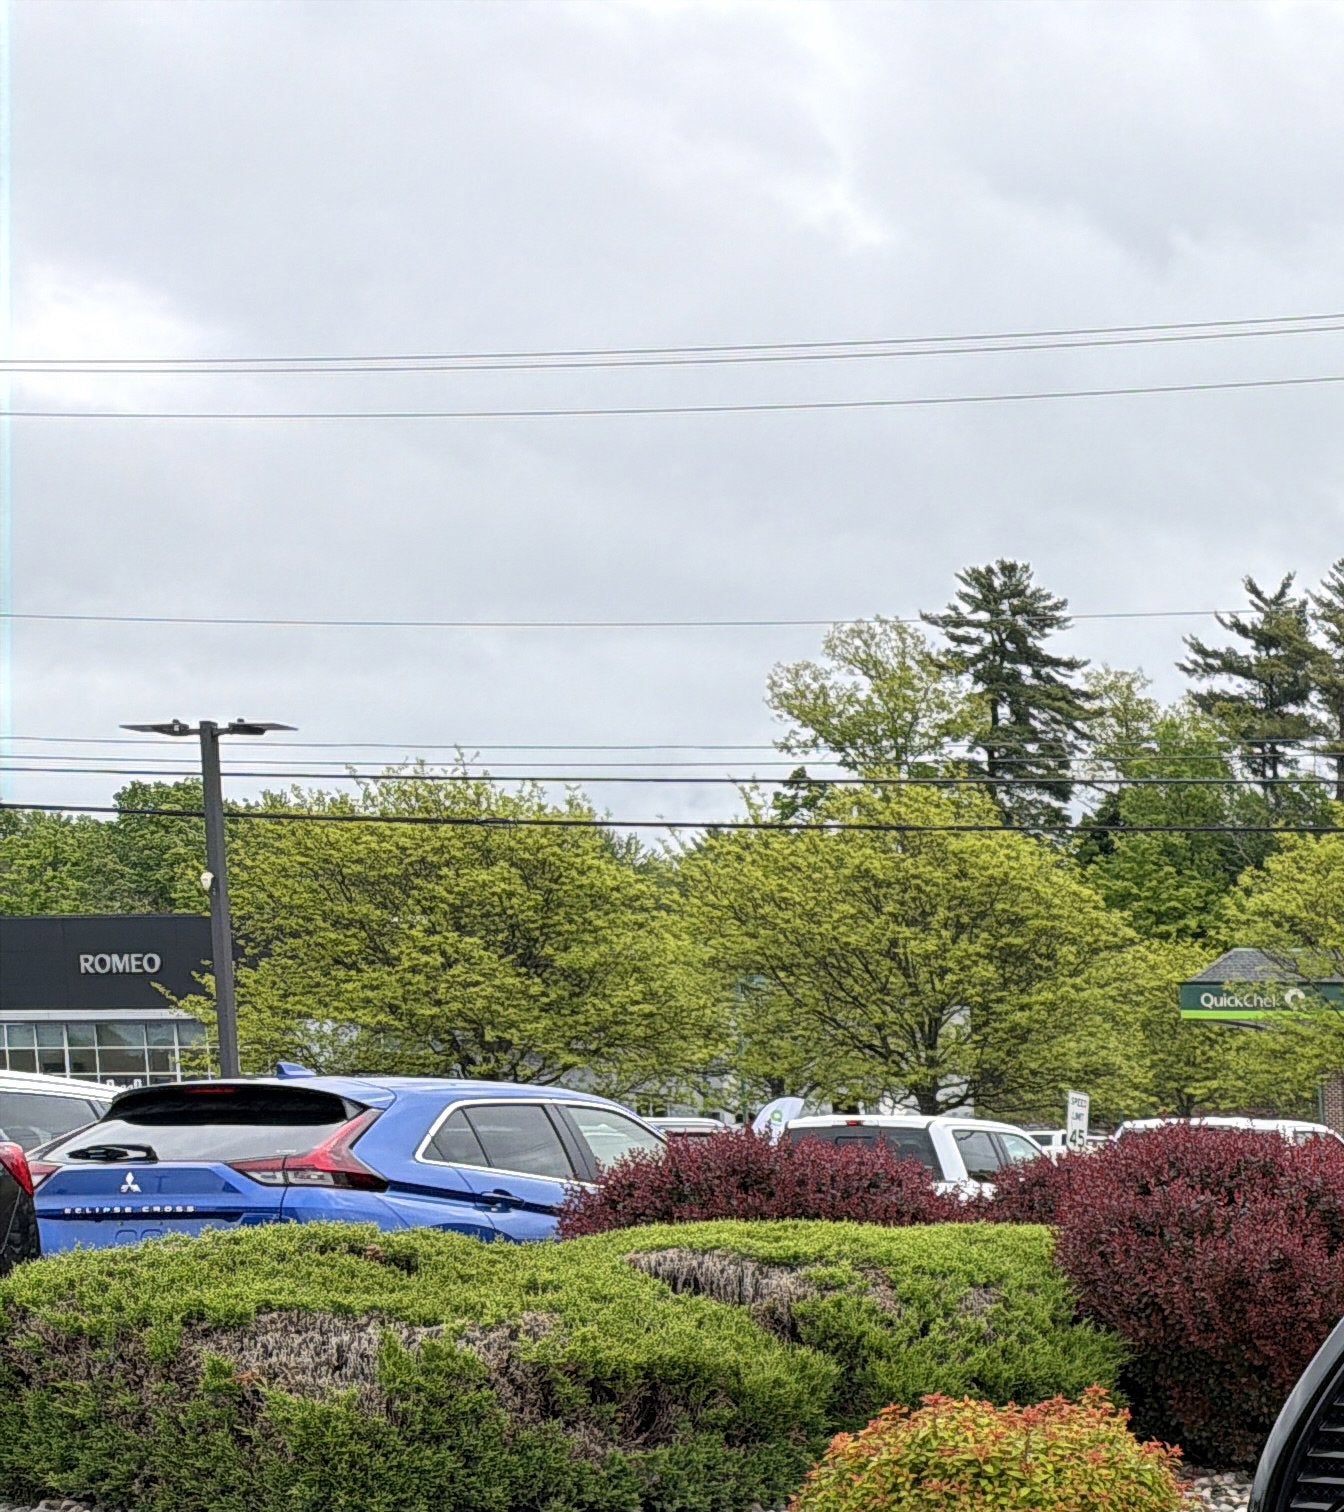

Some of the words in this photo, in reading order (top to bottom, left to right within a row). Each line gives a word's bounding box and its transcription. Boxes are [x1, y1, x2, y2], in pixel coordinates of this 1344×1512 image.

[79, 953, 161, 974] ROMEO
[1070, 1129, 1085, 1147] 45
[64, 1206, 133, 1214] ECLIPSE
[141, 1205, 195, 1213] CROSS
